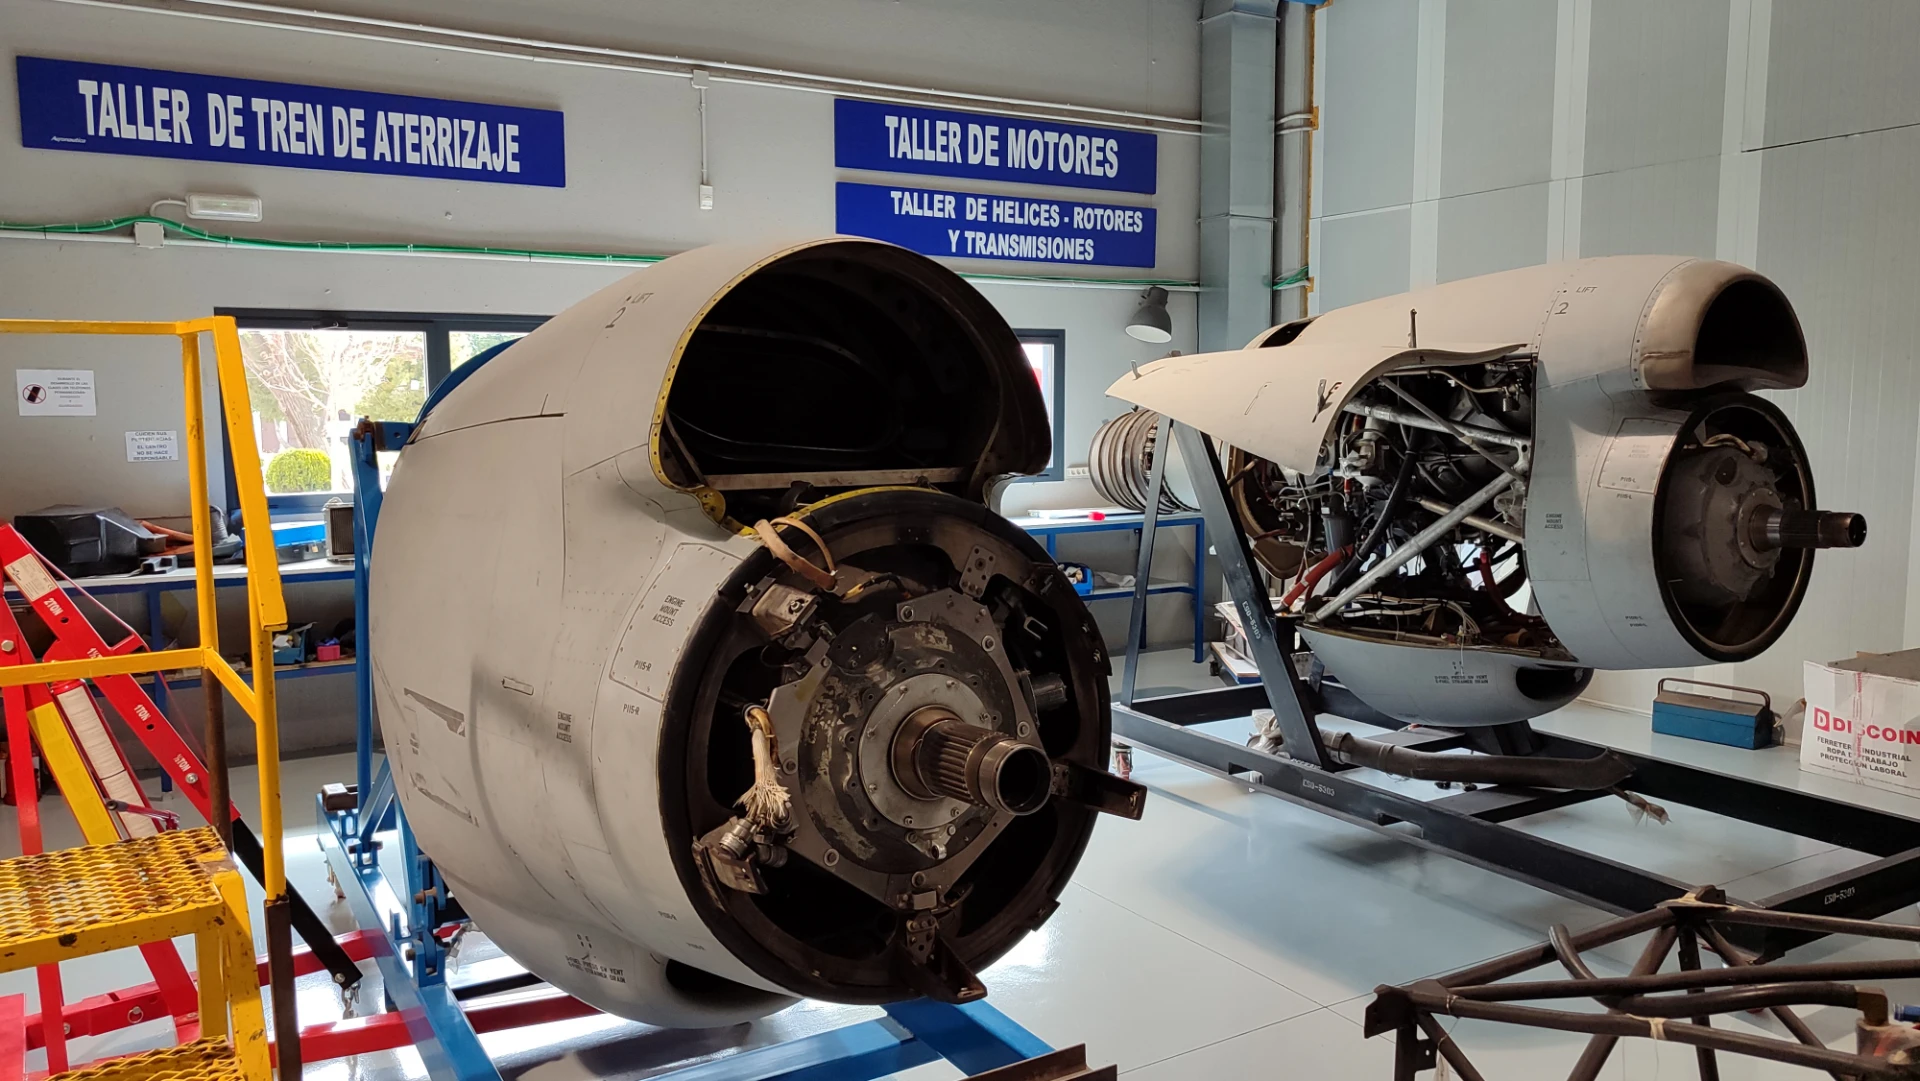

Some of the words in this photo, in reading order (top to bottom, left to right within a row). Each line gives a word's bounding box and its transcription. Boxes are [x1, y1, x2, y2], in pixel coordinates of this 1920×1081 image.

[79, 79, 193, 144] TALLER
[207, 92, 245, 150] DE
[252, 98, 324, 156] TREN
[332, 105, 366, 160] DE
[374, 111, 520, 173] ATERRIZAJE
[885, 115, 962, 163] TALLER
[967, 123, 1000, 166] DE
[1007, 127, 1119, 178] MOTORES
[891, 191, 956, 219] TALLER
[966, 197, 987, 222] DE
[992, 200, 1060, 228] HELICES
[1073, 207, 1143, 233] ROTORES
[948, 229, 960, 253] Y
[964, 231, 1095, 261] TRANSMISIONES
[1575, 286, 1598, 294] LIFT
[1554, 301, 1569, 315] 2
[664, 594, 686, 608] ENGINE
[659, 604, 680, 617] MOUNT
[652, 613, 675, 627] ACCESS
[557, 710, 572, 723] ENGINE
[556, 731, 572, 744] ACCESS
[1826, 746, 1847, 757] ROPA
[1861, 755, 1899, 768] TRABAJO
[1862, 747, 1912, 762] INDUSTRIAL
[1869, 765, 1908, 778] LABORAL
